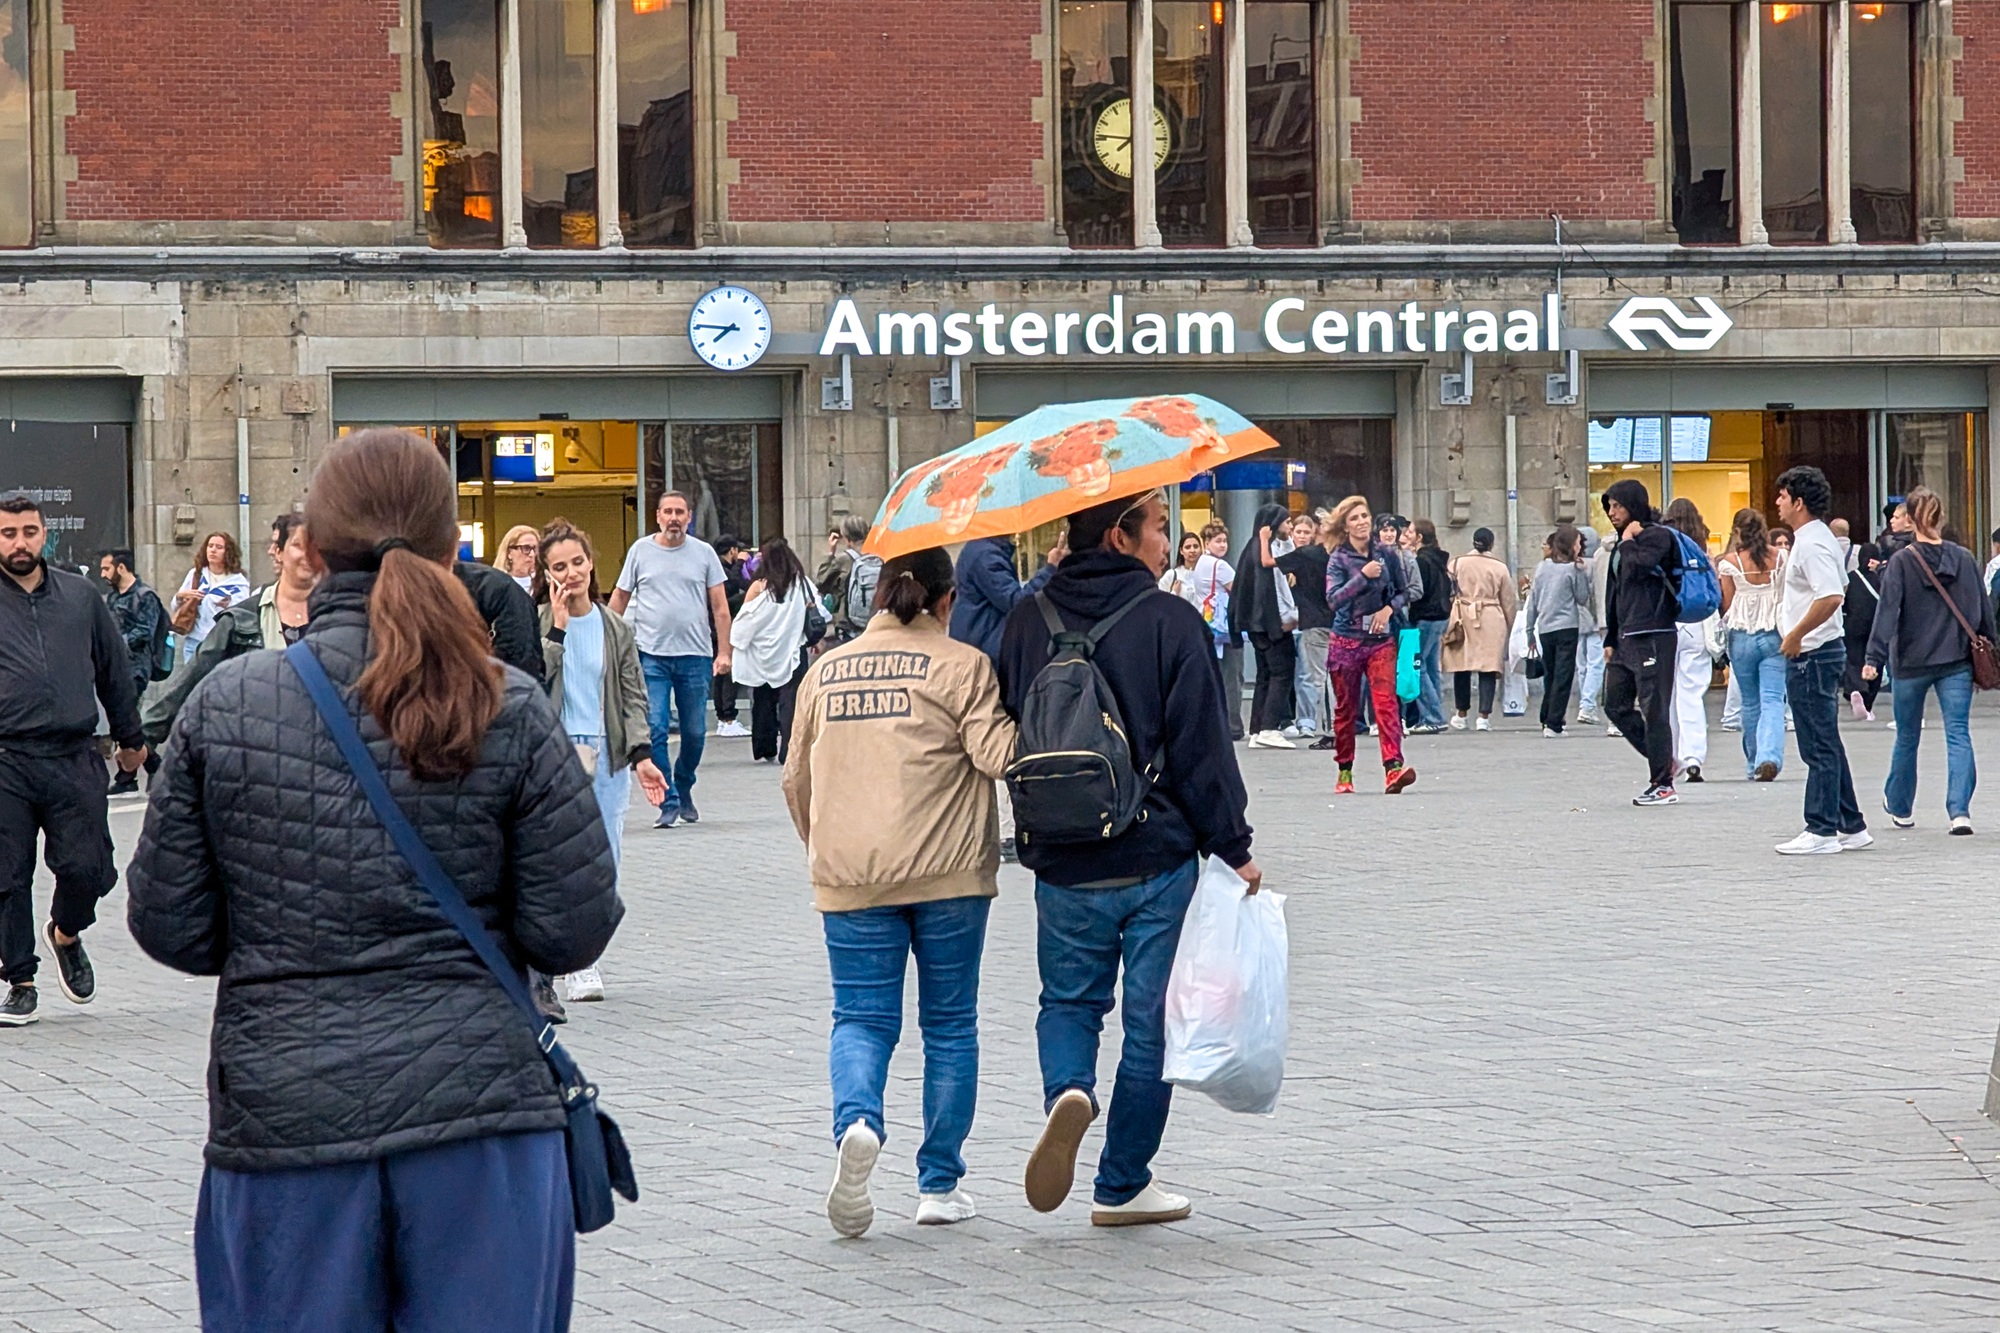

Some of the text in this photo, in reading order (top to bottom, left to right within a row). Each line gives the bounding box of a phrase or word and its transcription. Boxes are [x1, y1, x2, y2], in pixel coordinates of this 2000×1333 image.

[819, 293, 1560, 356] Amsterdam Centraal
[821, 654, 928, 683] ORIGINAL
[828, 691, 910, 718] BRAND
